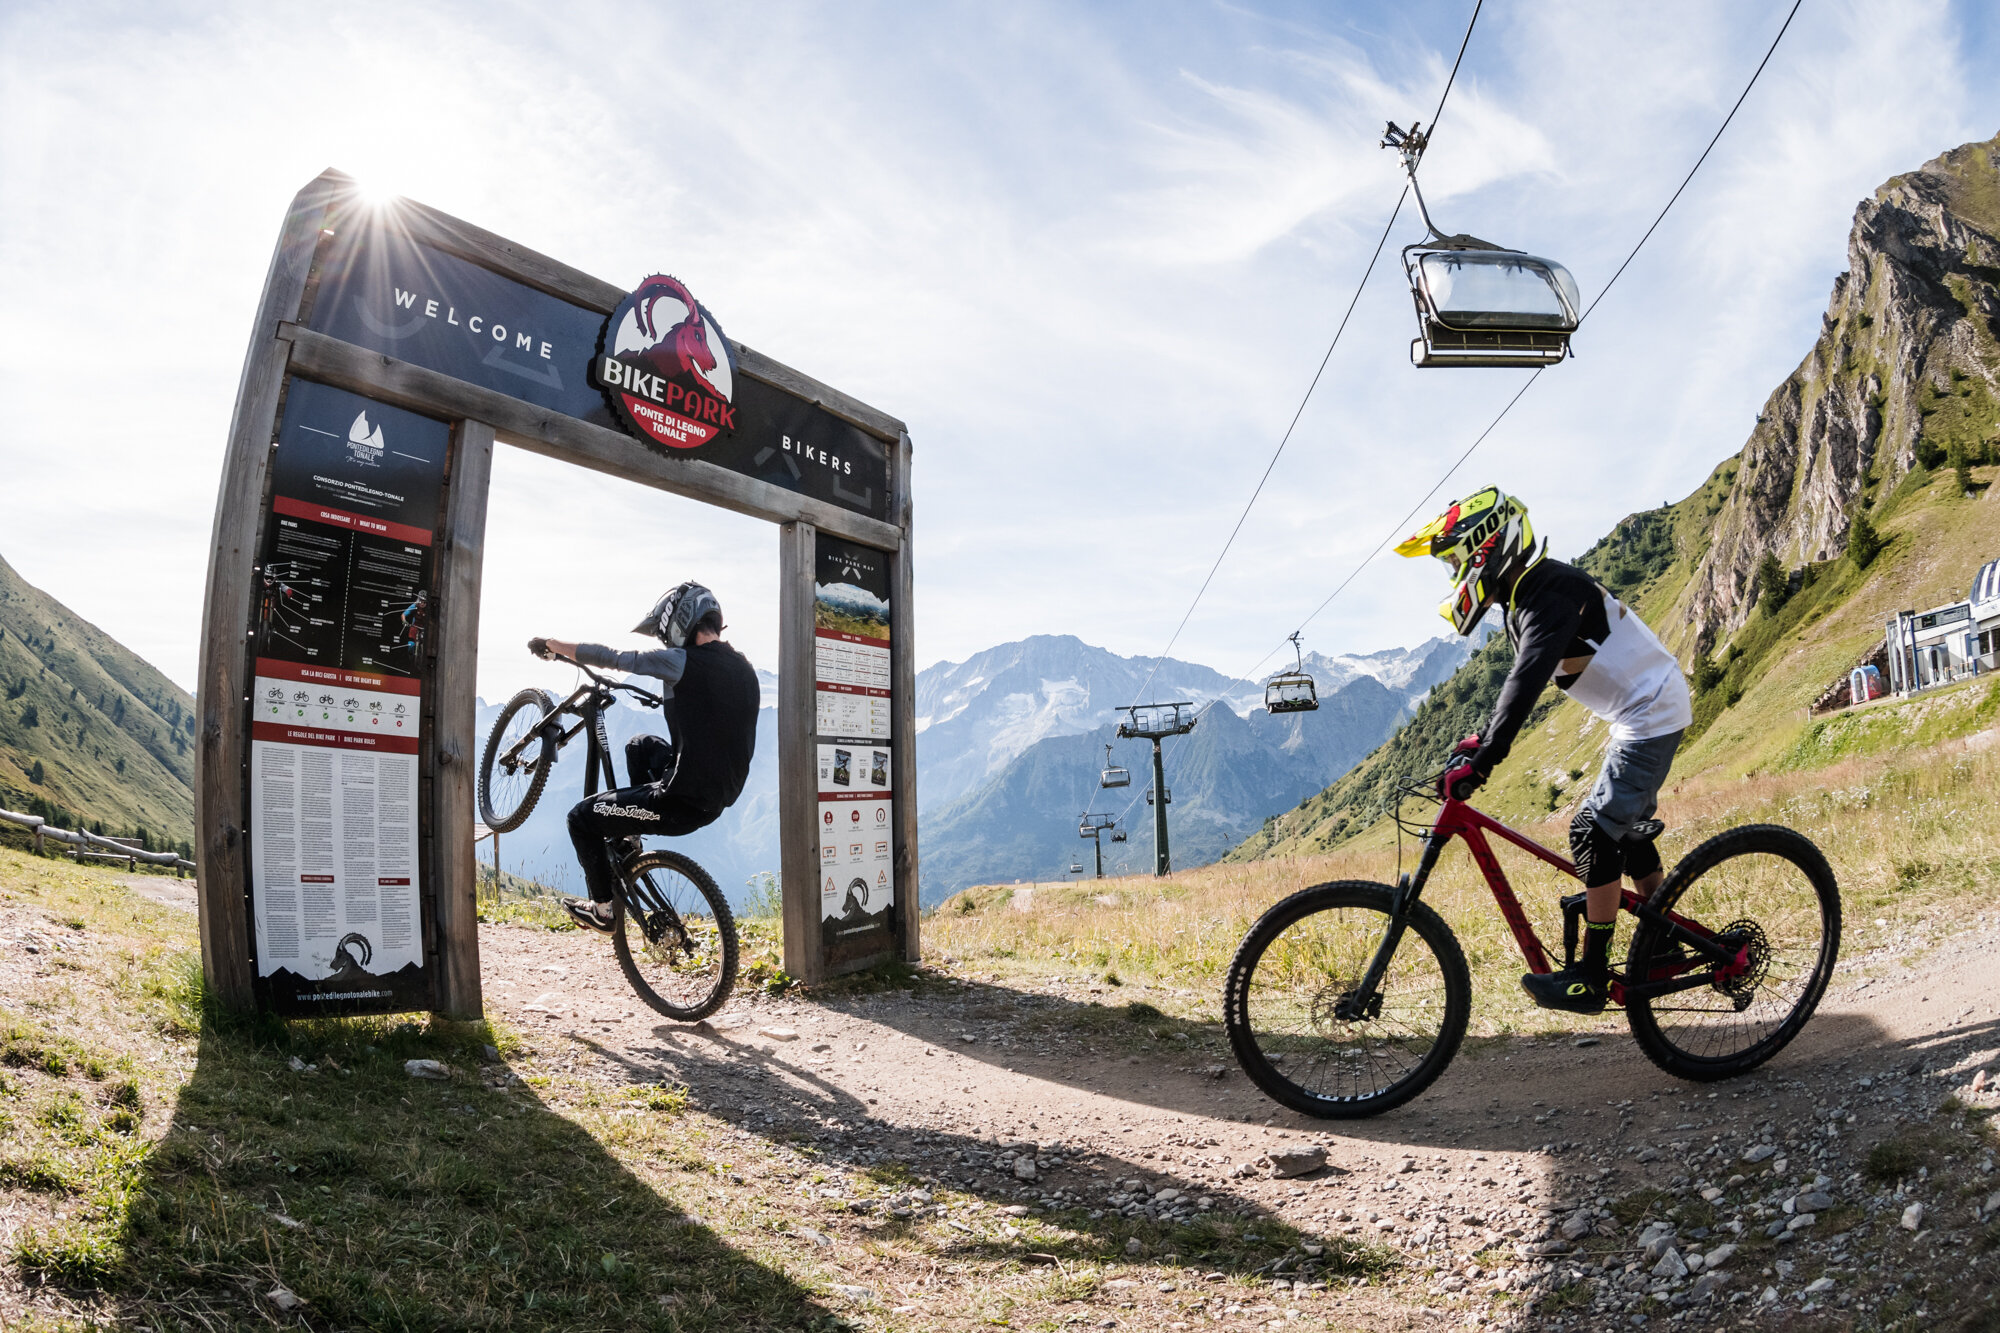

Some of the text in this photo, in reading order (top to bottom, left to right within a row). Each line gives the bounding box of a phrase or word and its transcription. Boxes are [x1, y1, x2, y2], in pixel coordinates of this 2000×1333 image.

[394, 287, 553, 360] WELCOME
[633, 403, 706, 438] PONTE DI LEGNO
[652, 421, 687, 442] TONALE
[346, 441, 384, 457] PONTEDILEGNO
[354, 449, 375, 462] TONALE
[782, 435, 851, 475] BIKERS
[312, 474, 344, 487] CONSORZIO
[344, 482, 405, 502] PONTEDILEGNO-TONALE
[1466, 498, 1483, 511] XS
[320, 511, 330, 519] COSA
[359, 519, 371, 528] WHAT
[376, 523, 387, 532] WEAR
[1461, 500, 1517, 556] 100%
[828, 554, 875, 572] BIKE PARK MAP
[658, 591, 682, 635] 100%
[323, 672, 337, 680] GIUSTA
[360, 677, 372, 685] RIGHT
[372, 678, 381, 686] BIKE
[292, 731, 307, 739] REGOLE
[325, 734, 336, 742] PARK
[592, 801, 611, 817] Troy
[610, 803, 626, 817] Lee
[1232, 966, 1248, 1026] MAXXIS
